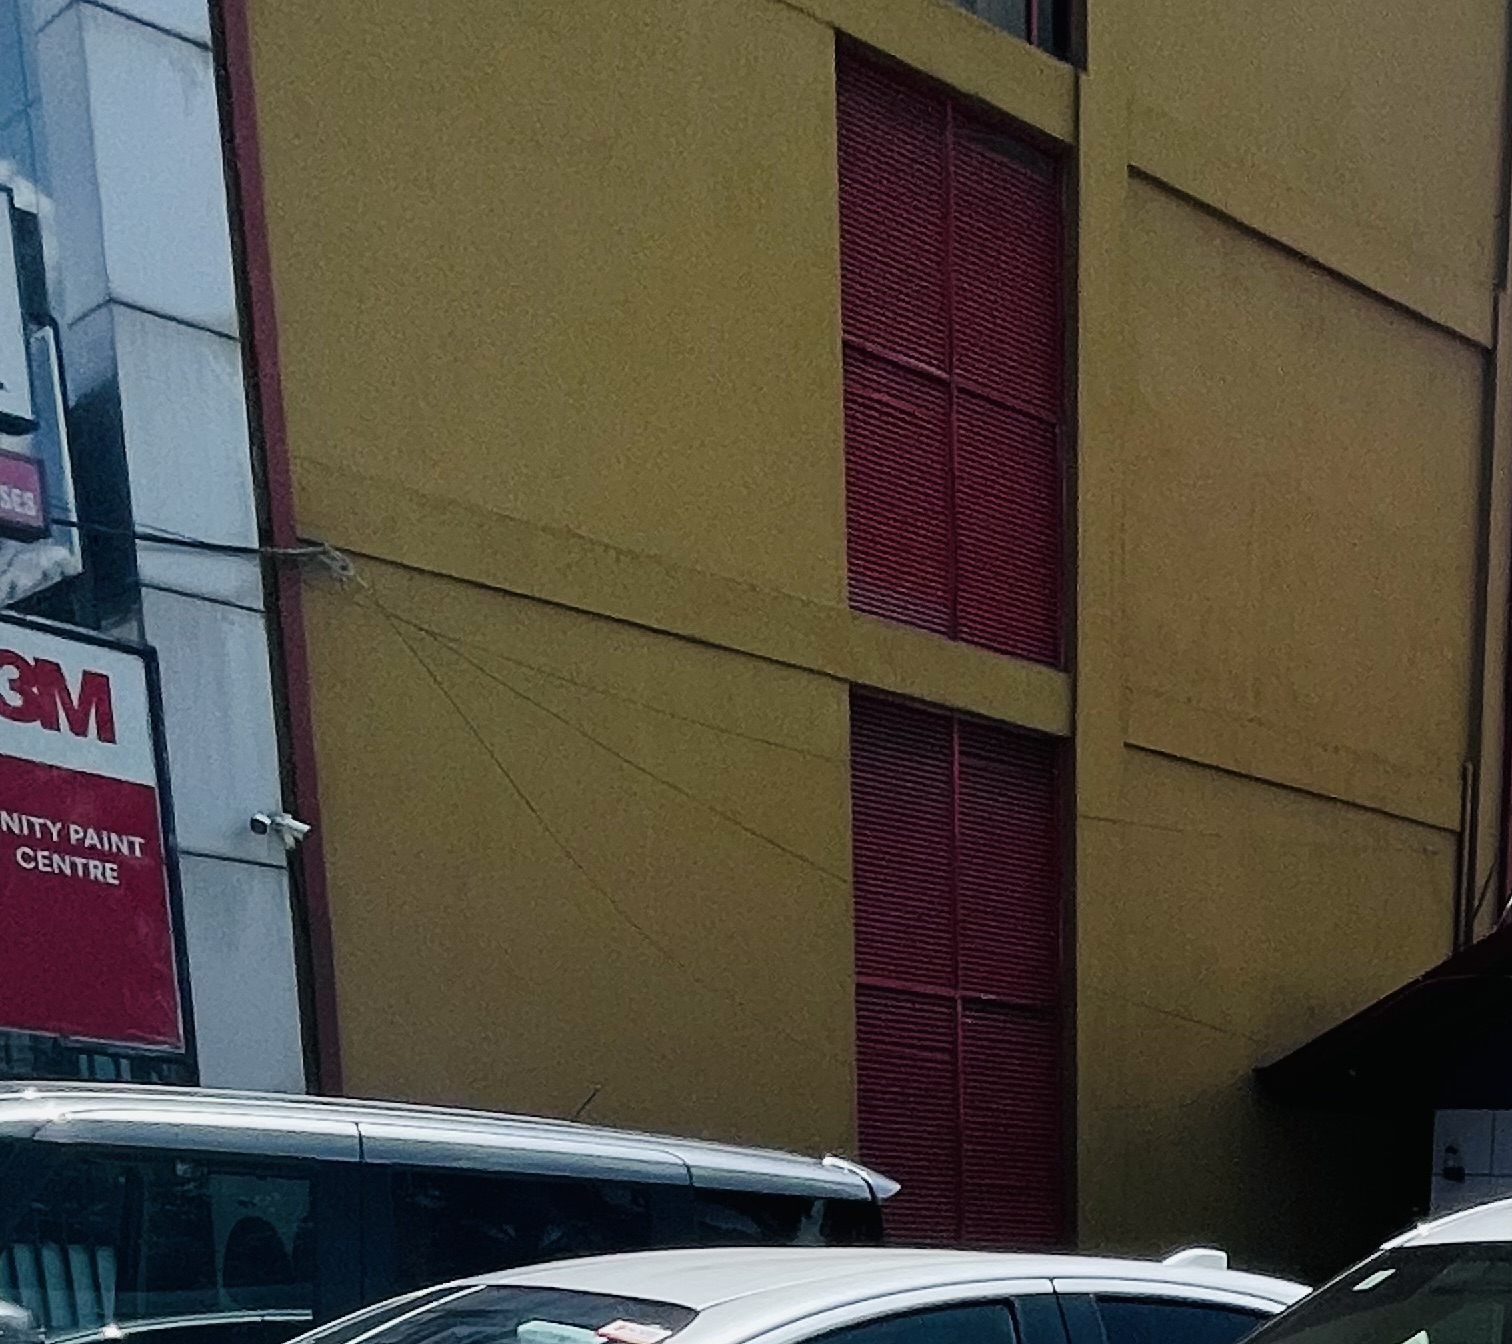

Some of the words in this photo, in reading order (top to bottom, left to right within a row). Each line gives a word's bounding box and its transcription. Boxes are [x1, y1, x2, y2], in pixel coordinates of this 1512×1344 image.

[0, 648, 117, 744] 3M
[0, 810, 62, 842] NITY
[68, 823, 145, 858] PAINT
[16, 846, 120, 885] CENTRE
